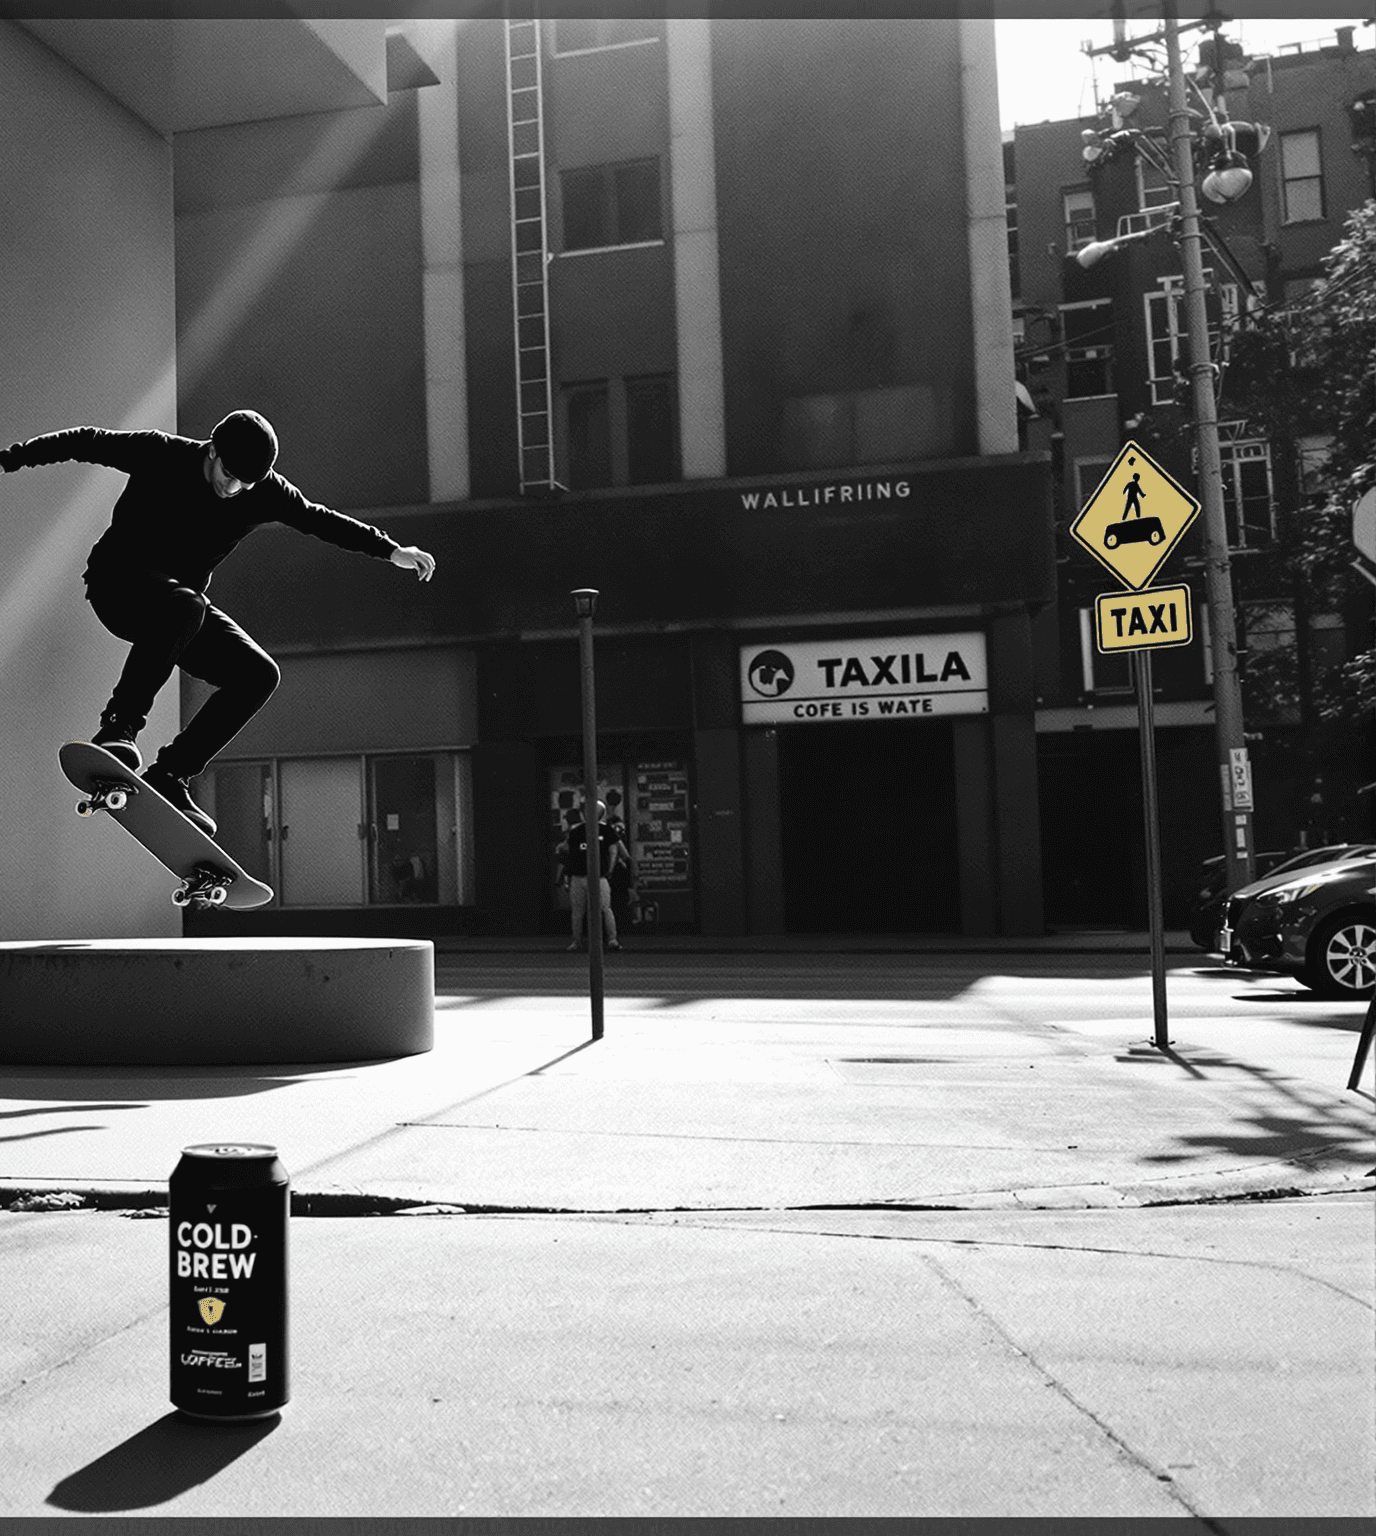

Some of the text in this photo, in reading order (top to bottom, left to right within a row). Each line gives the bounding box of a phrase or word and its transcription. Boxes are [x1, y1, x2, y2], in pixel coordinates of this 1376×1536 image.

[740, 481, 911, 510] WALLIFRIING
[1110, 603, 1178, 637] TAXI
[817, 651, 972, 688] TAXILA
[793, 699, 933, 718] COFE IS WATE
[177, 1221, 252, 1250] COLD
[177, 1250, 257, 1279] BREW
